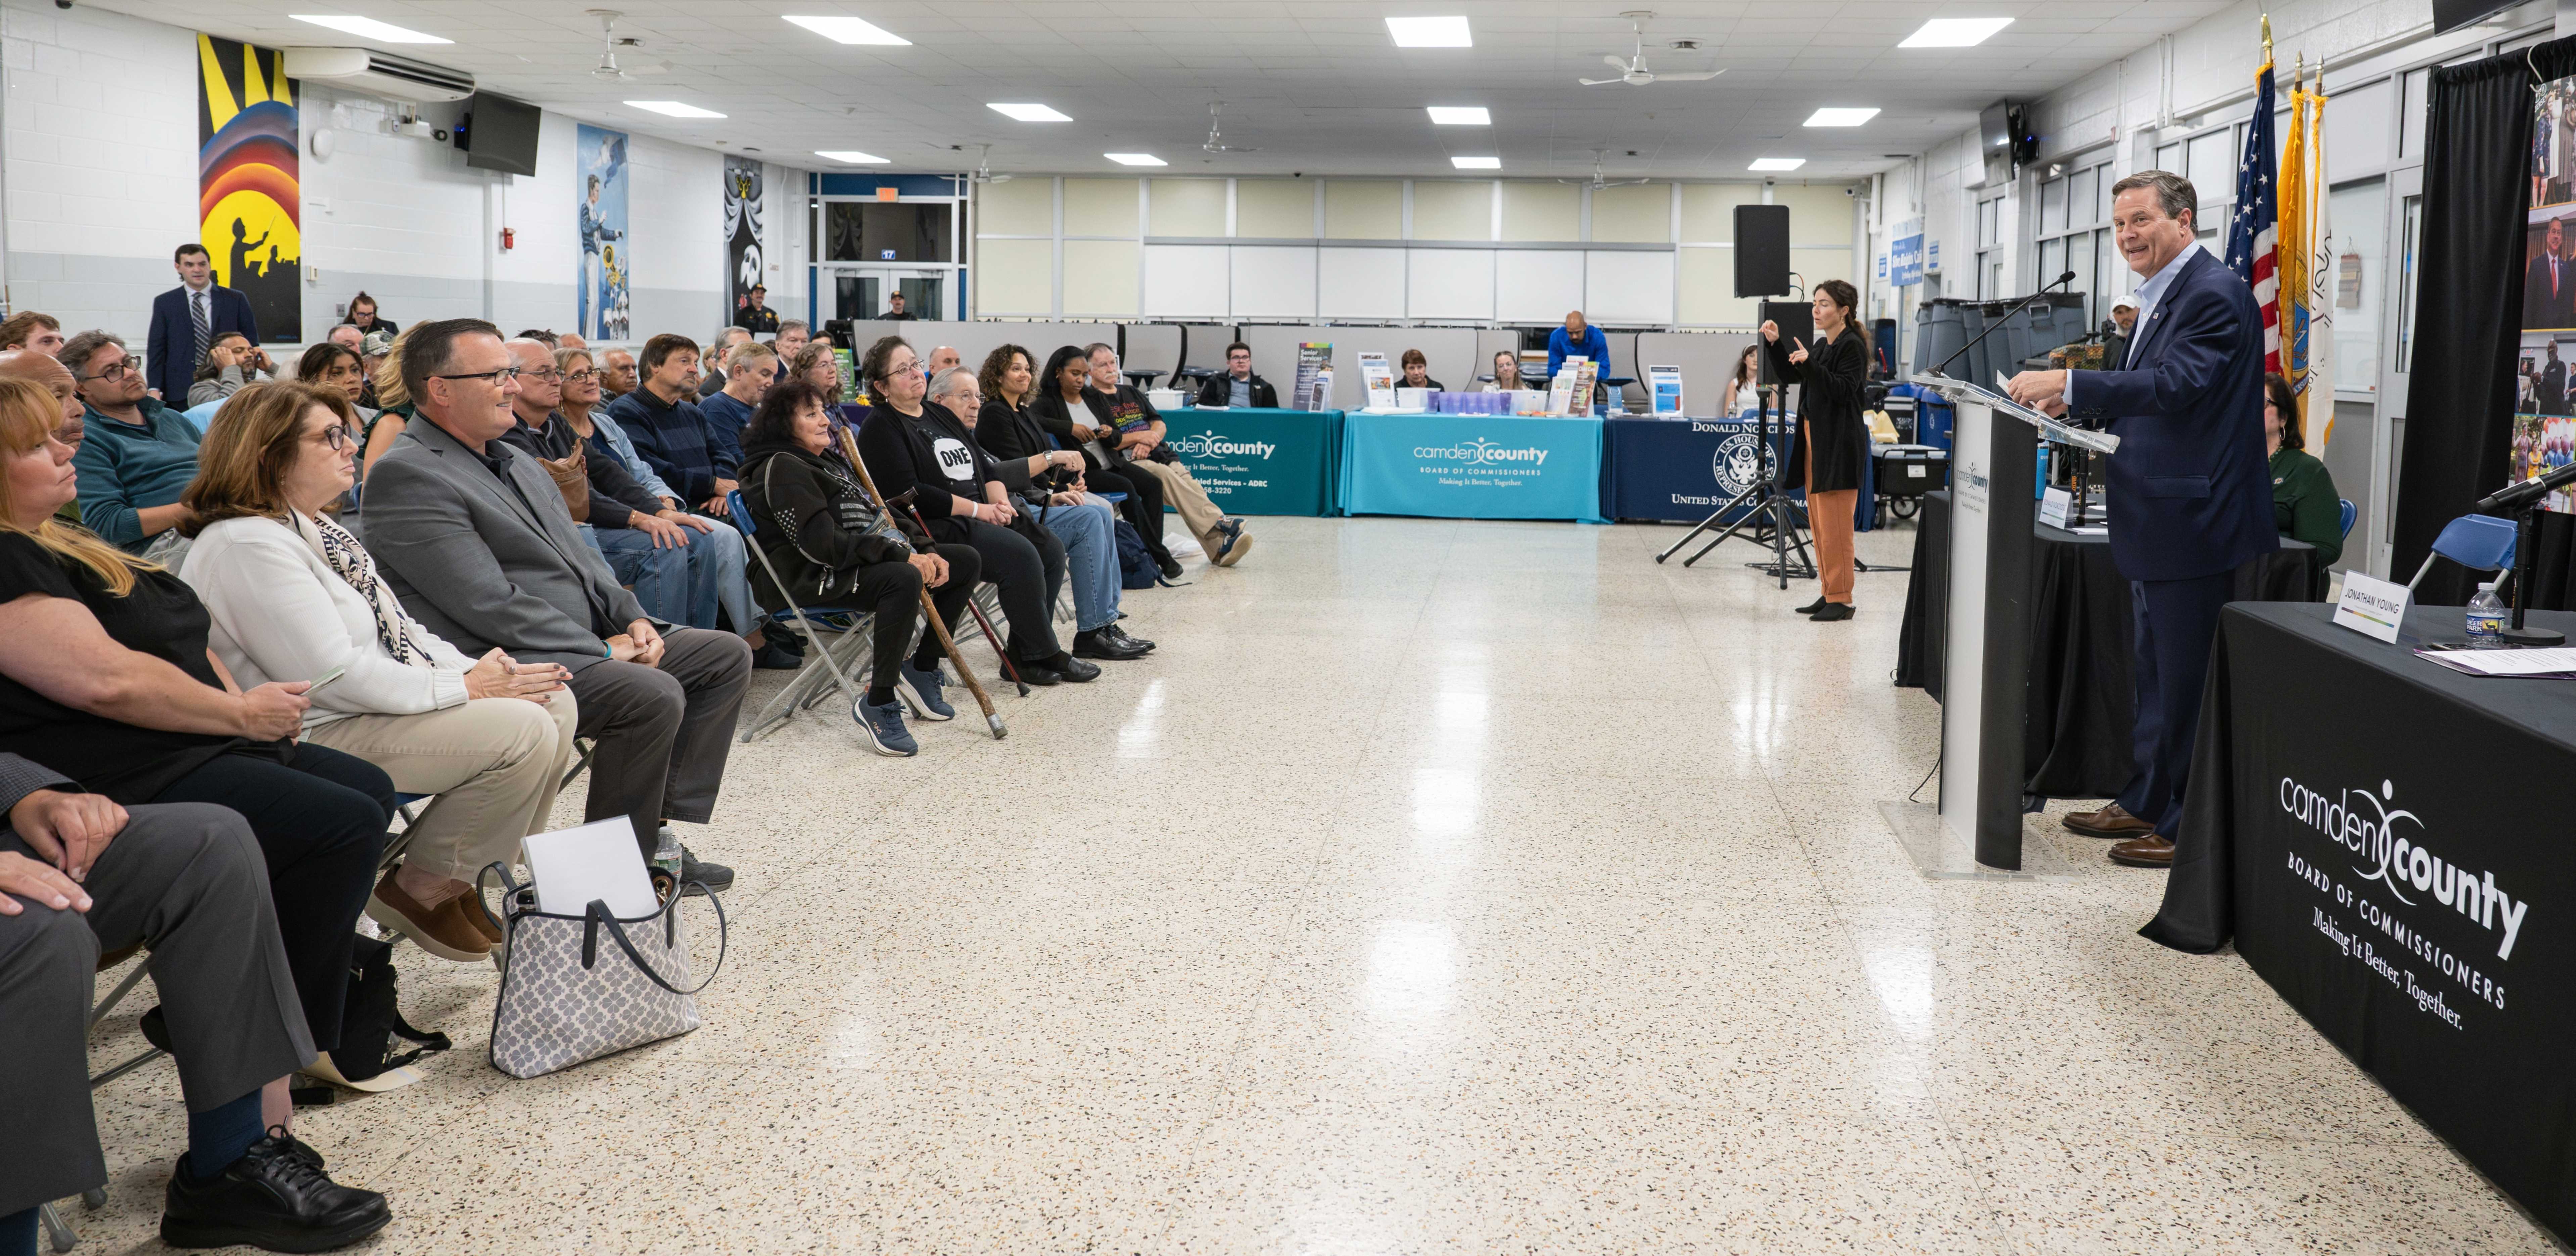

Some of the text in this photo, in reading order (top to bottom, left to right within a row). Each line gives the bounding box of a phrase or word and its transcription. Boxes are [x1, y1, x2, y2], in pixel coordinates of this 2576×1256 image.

[883, 250, 894, 259] 17
[1692, 422, 1740, 433] DONALD
[1213, 441, 1275, 460] county
[1720, 441, 1734, 454] U.S.
[1733, 436, 1759, 445] HOUS
[940, 447, 971, 467] ONE
[1413, 444, 1548, 465] camden county
[1439, 478, 1463, 486] Making
[1471, 479, 1492, 487] Better,
[1493, 479, 1523, 487] Together.
[1973, 475, 1988, 493] county
[1671, 494, 1709, 504] UNITED
[2345, 588, 2376, 606] JONATHAN
[2377, 598, 2400, 614] YOUNG
[2467, 619, 2482, 627] DEER
[2281, 777, 2528, 961] camden county
[2288, 852, 2504, 1010] BOARD OF COMMISSIONERS
[2313, 907, 2463, 1031] Making It Better, Together.
